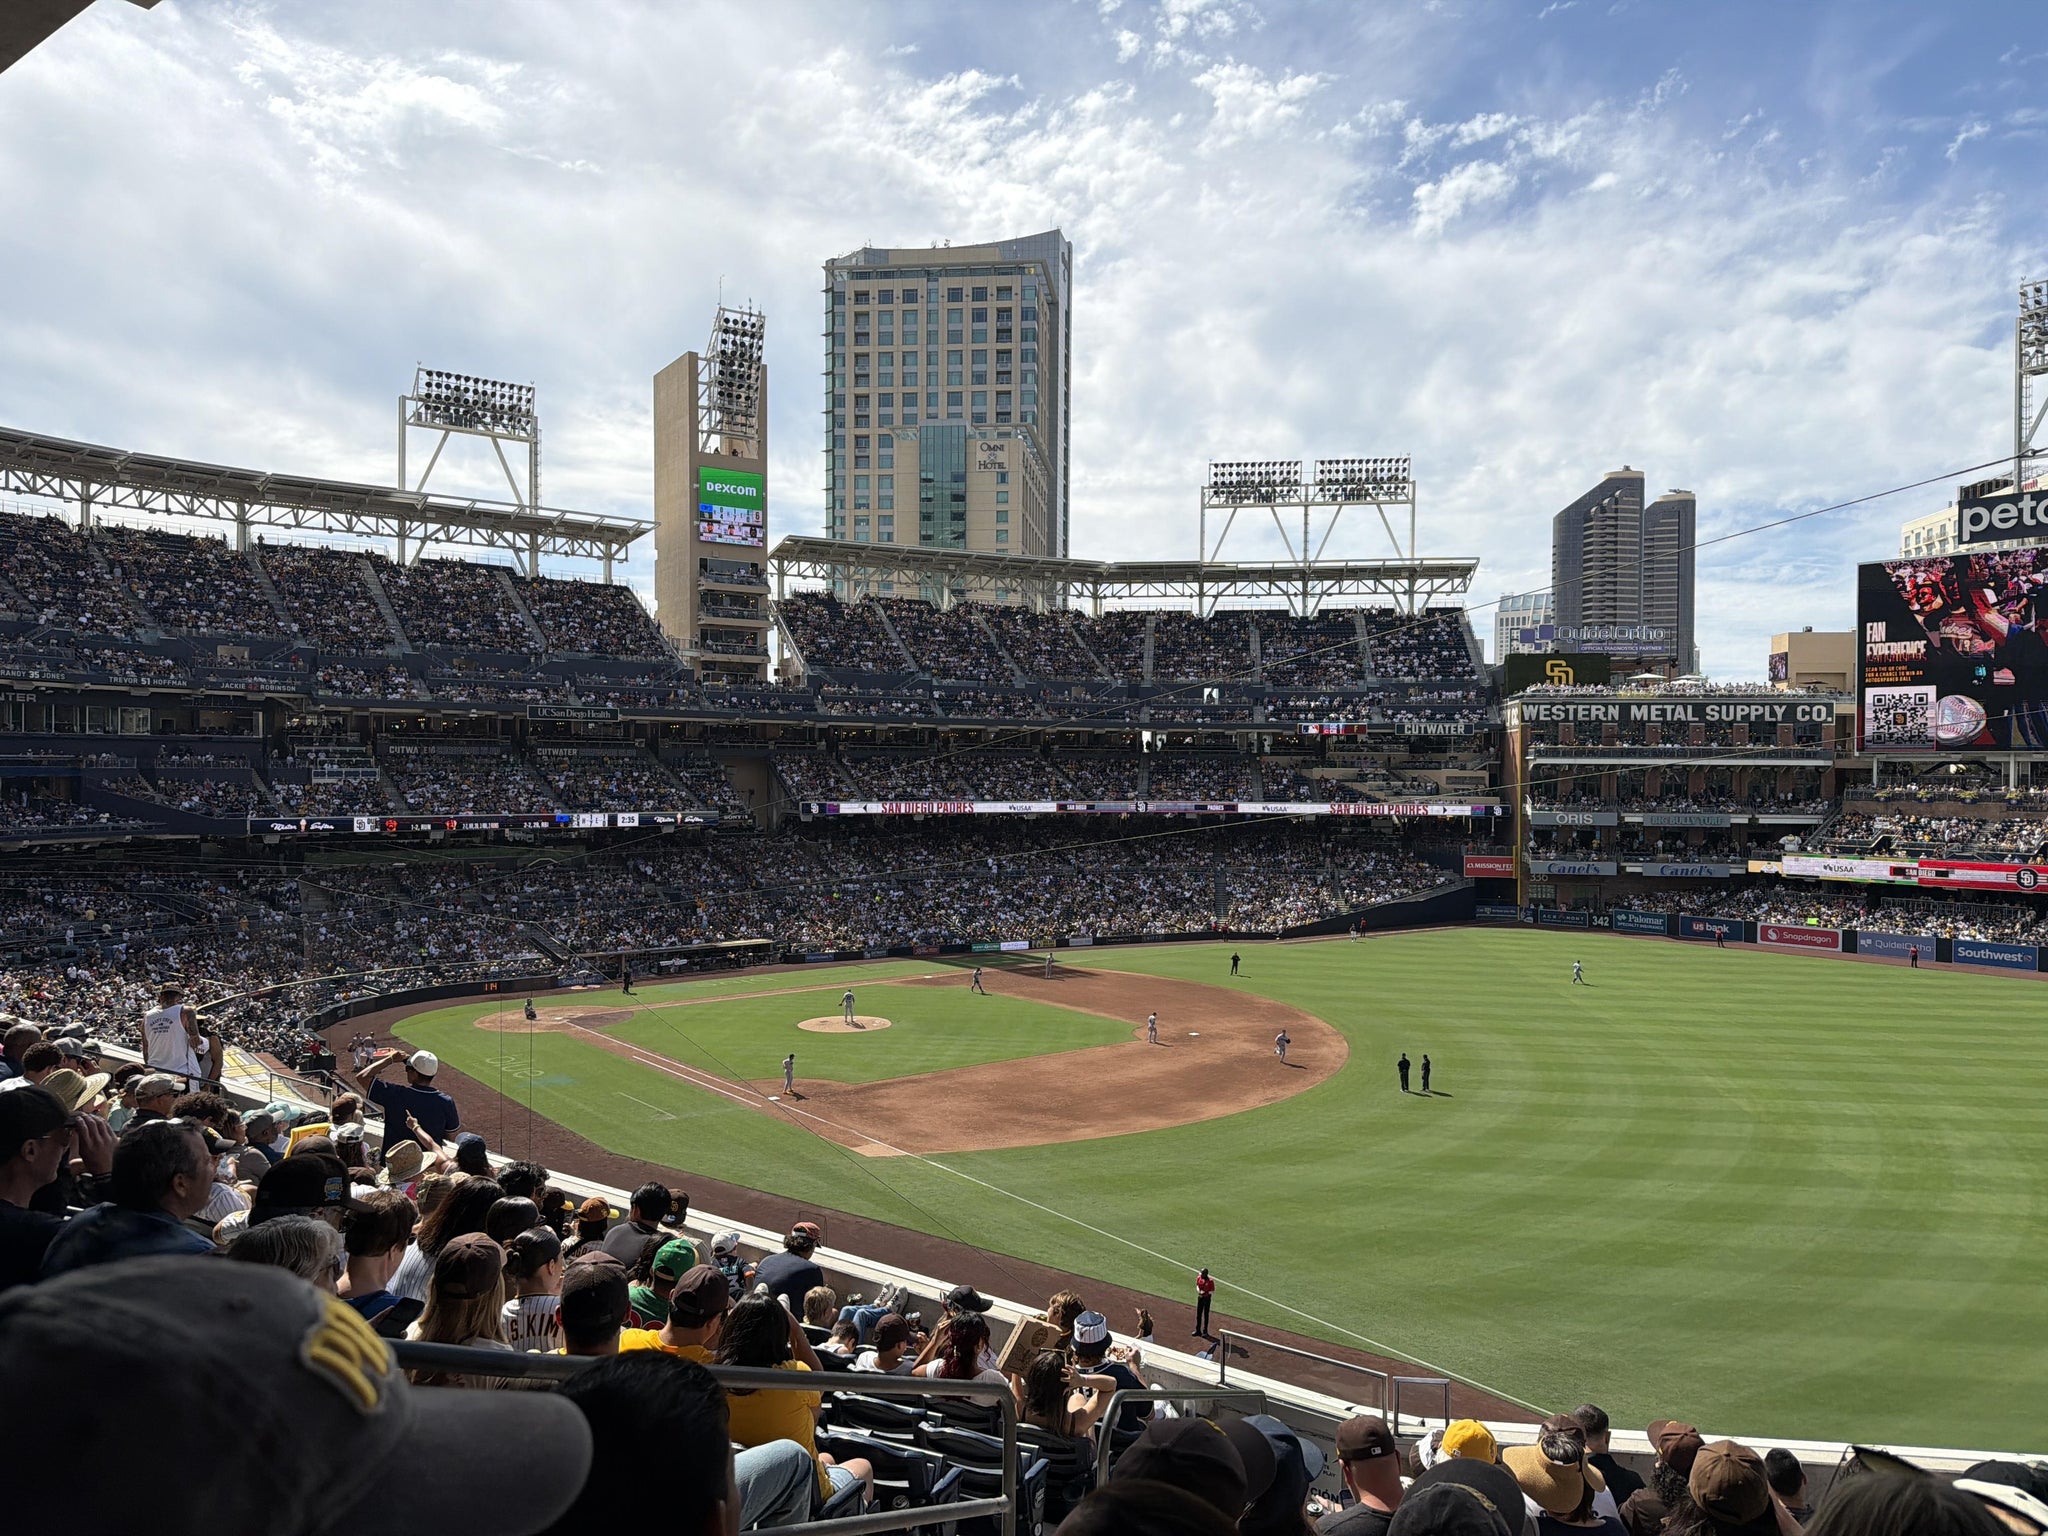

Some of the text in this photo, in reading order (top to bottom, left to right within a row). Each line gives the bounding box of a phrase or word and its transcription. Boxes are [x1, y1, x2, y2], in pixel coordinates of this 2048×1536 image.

[980, 442, 1004, 452] OMNI
[978, 461, 1006, 470] HOTEL
[1559, 625, 1665, 643] QuidelOrtho
[1866, 621, 1886, 642] FAN
[1866, 641, 1927, 661] EXPERIENCE
[0, 669, 66, 680] RANDY 35 JONES
[108, 676, 187, 686] TREVOR 51 HOFFMAN
[260, 684, 296, 692] ROBINSON
[566, 709, 587, 719] Diego
[588, 709, 611, 719] Health
[1521, 704, 1620, 722] WESTERN
[1630, 704, 1699, 722] METAL
[1705, 704, 1787, 722] SUPPLY
[1796, 704, 1832, 722] CO.
[1404, 724, 1465, 734] CUTWATER
[537, 748, 577, 756] CUTWATER
[881, 802, 974, 814] SAN DIEGO PADRES
[1329, 803, 1428, 815] SAN DIEGO PADRES
[1555, 813, 1593, 825] ORIS
[1651, 815, 1723, 825] BIG BULLY TURF
[1547, 862, 1600, 874] Canel's
[1660, 864, 1713, 876] Canel's
[1905, 868, 1936, 877] SAN DIEGO
[1592, 916, 1609, 927] 342
[1628, 914, 1664, 926] Palomar
[1692, 922, 1730, 933] us bank
[1782, 931, 1832, 943] Snapdragon
[1957, 946, 2023, 962] Southwest
